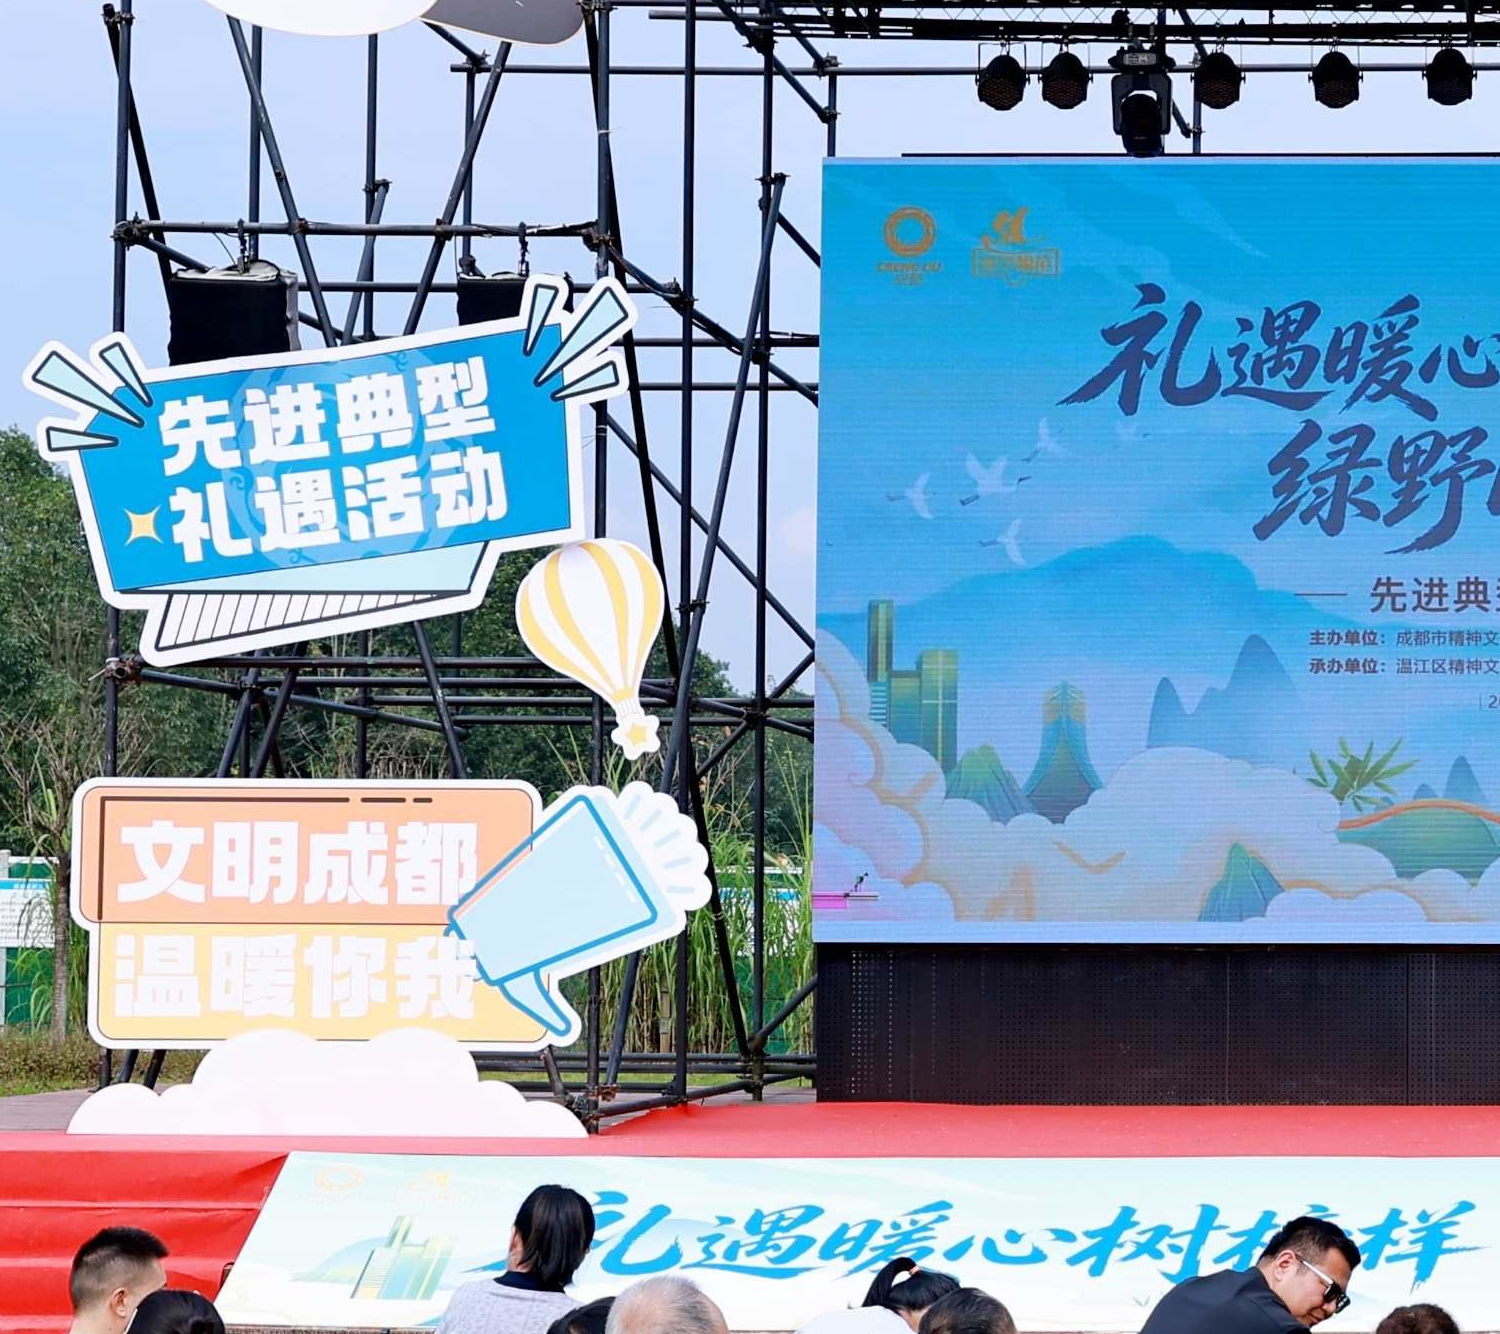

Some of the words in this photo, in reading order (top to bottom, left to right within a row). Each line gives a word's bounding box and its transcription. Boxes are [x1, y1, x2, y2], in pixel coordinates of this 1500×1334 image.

[157, 356, 497, 477] 先进典型
[168, 446, 509, 564] 礼遇活动
[116, 819, 478, 906] 文明成都
[113, 933, 477, 1020] 温暖你我
